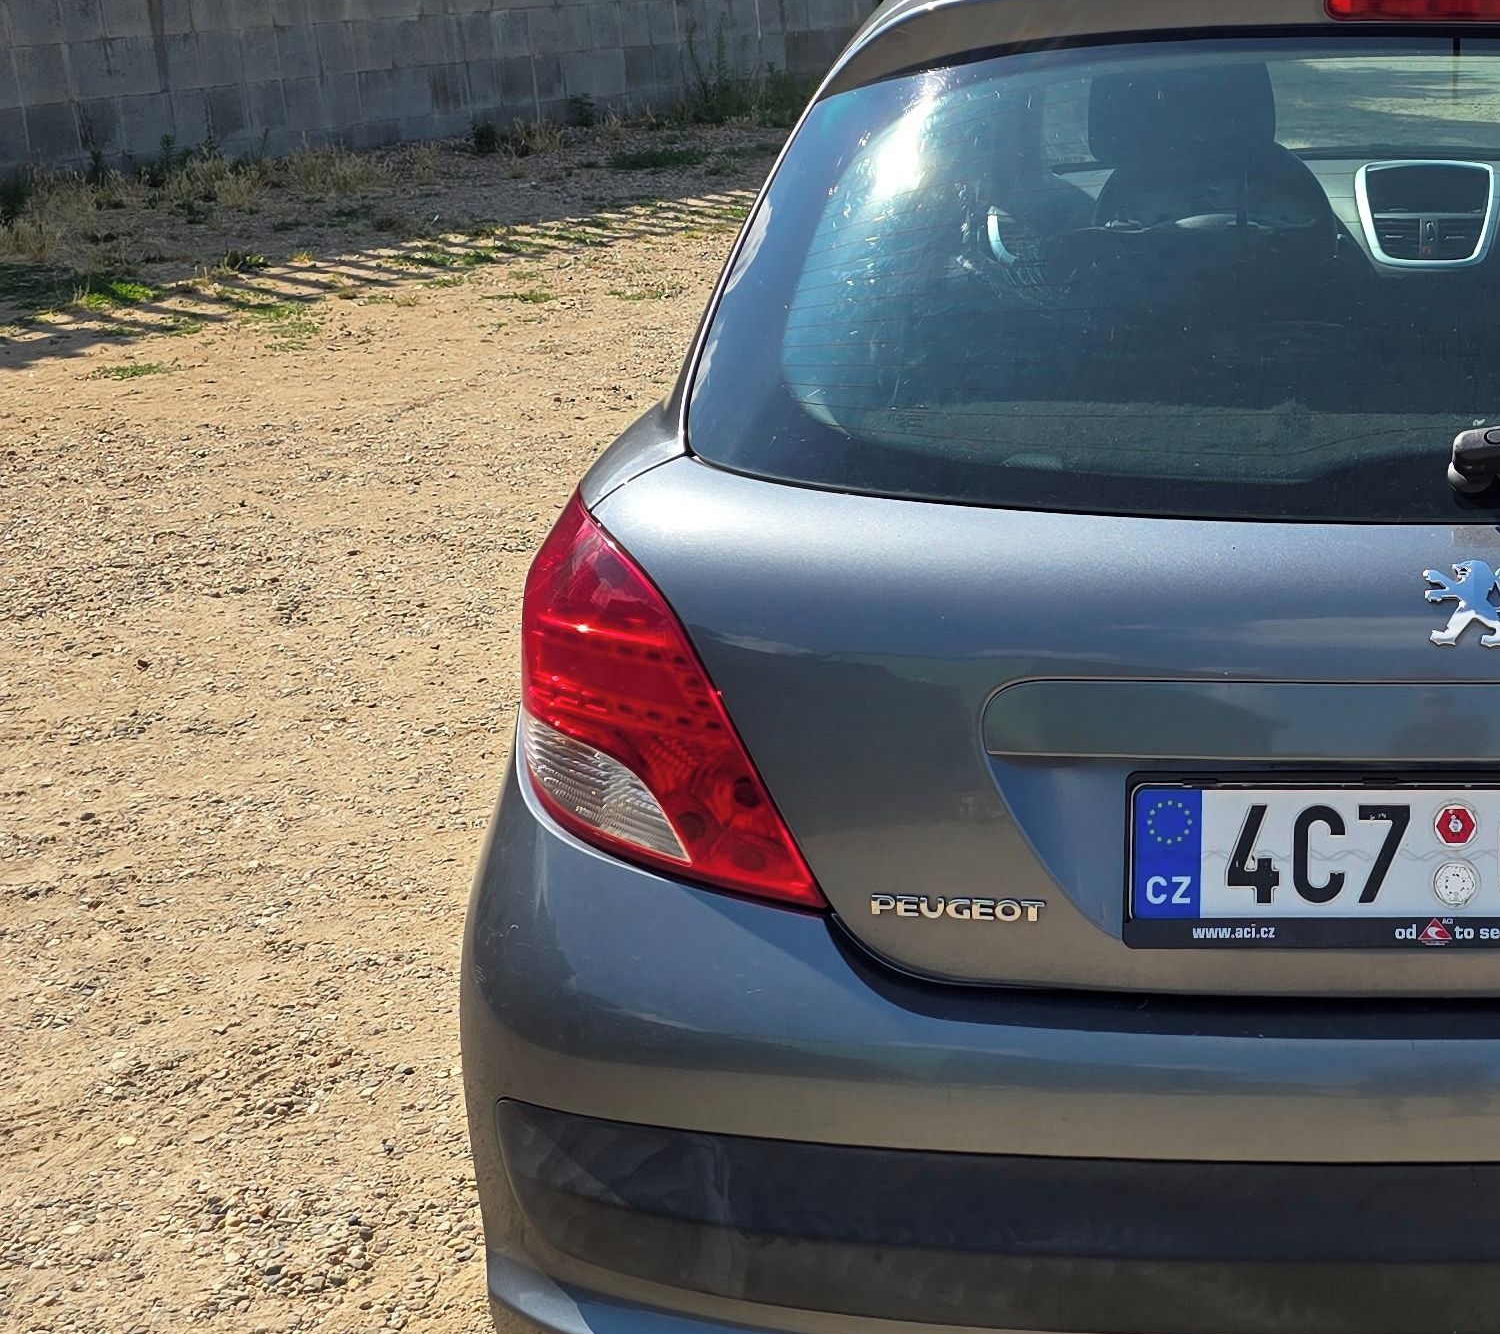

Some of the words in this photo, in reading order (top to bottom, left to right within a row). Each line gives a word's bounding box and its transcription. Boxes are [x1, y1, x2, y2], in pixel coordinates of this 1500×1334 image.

[1226, 804, 1411, 904] 4C7
[1146, 876, 1191, 906] CZ
[871, 893, 1046, 922] PEUGEOT
[1192, 924, 1276, 941] www.aci.cz
[1394, 923, 1417, 940] od
[1454, 925, 1475, 940] to
